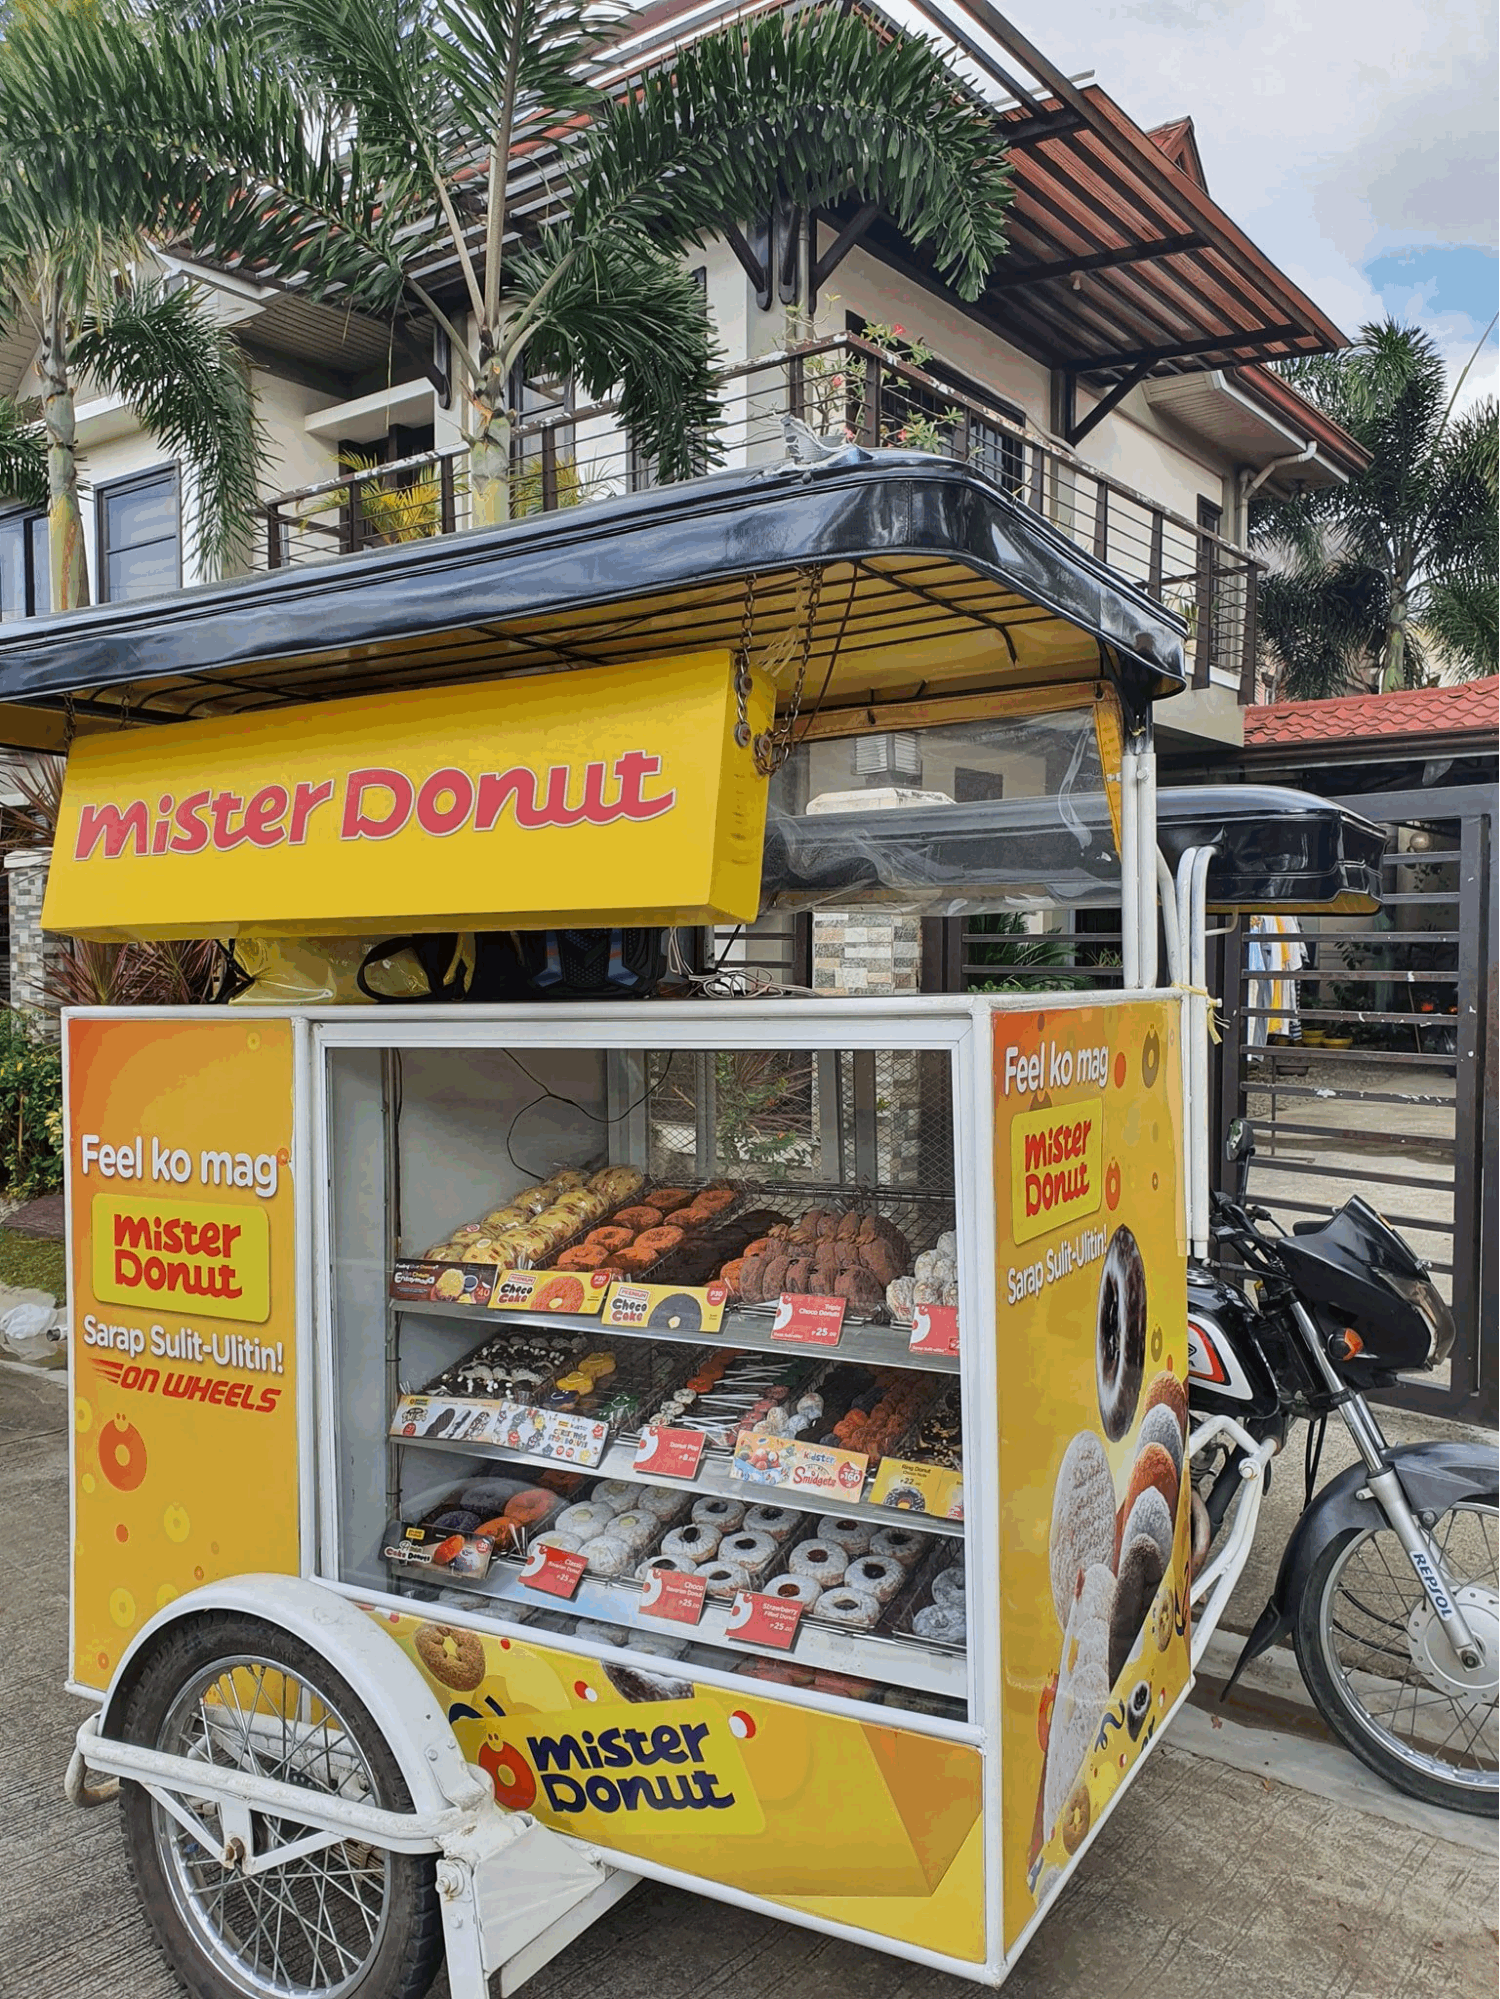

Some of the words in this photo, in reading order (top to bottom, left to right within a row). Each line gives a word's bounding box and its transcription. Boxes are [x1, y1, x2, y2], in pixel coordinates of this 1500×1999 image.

[340, 750, 676, 840] Donut
[1005, 1041, 1046, 1095] Feel
[1050, 1040, 1073, 1087] ko
[1076, 1045, 1109, 1087] mag
[81, 1134, 143, 1179] Feel
[151, 1136, 192, 1182] ko
[200, 1149, 279, 1198] mag
[1025, 1161, 1090, 1218] Donut
[114, 1248, 243, 1299] Donut
[1007, 1260, 1044, 1305] Sarap
[1046, 1223, 1108, 1283] Sulit-Ulitin!
[498, 1293, 528, 1303] Cake
[500, 1283, 533, 1294] Choco
[612, 1298, 647, 1312] Choco
[612, 1309, 642, 1321] Cake
[83, 1314, 145, 1358] Sarap
[150, 1324, 285, 1374] Sulit-Ulitin!
[119, 1365, 160, 1392] ON
[161, 1373, 282, 1413] WHEELS
[793, 1466, 836, 1487] Smidgets
[386, 1548, 406, 1558] Cake
[684, 1582, 704, 1591] Choco
[1413, 1553, 1453, 1618] REPSOL
[762, 1603, 798, 1615] Strawberry
[540, 1770, 736, 1814] Donut
